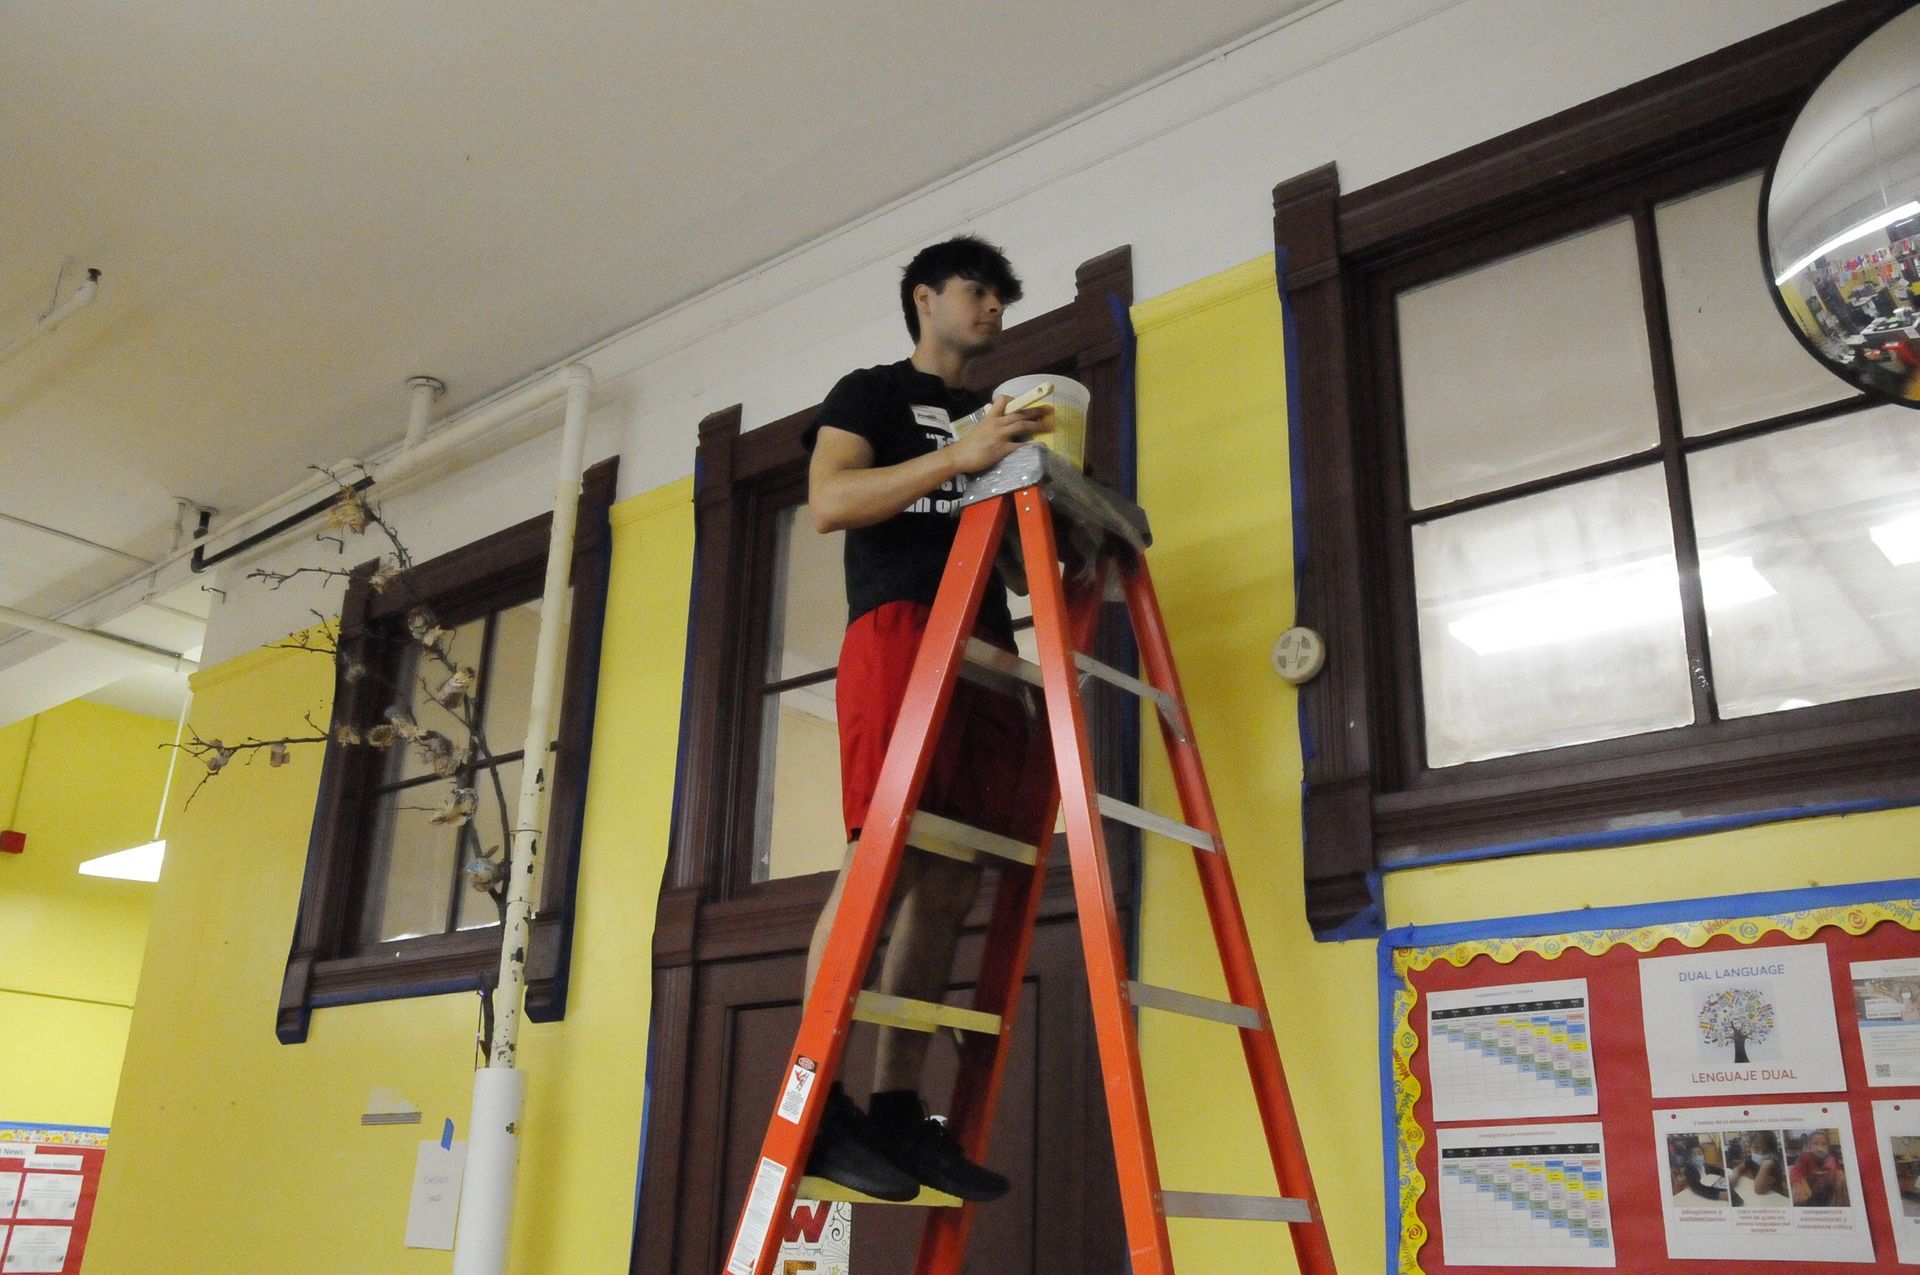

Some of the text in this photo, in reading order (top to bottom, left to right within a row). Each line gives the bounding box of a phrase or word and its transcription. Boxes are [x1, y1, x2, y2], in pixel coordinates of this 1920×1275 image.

[1679, 964, 1784, 982] DUAL LANGUAGE
[1691, 1069, 1797, 1083] LENGUAJE DUAL
